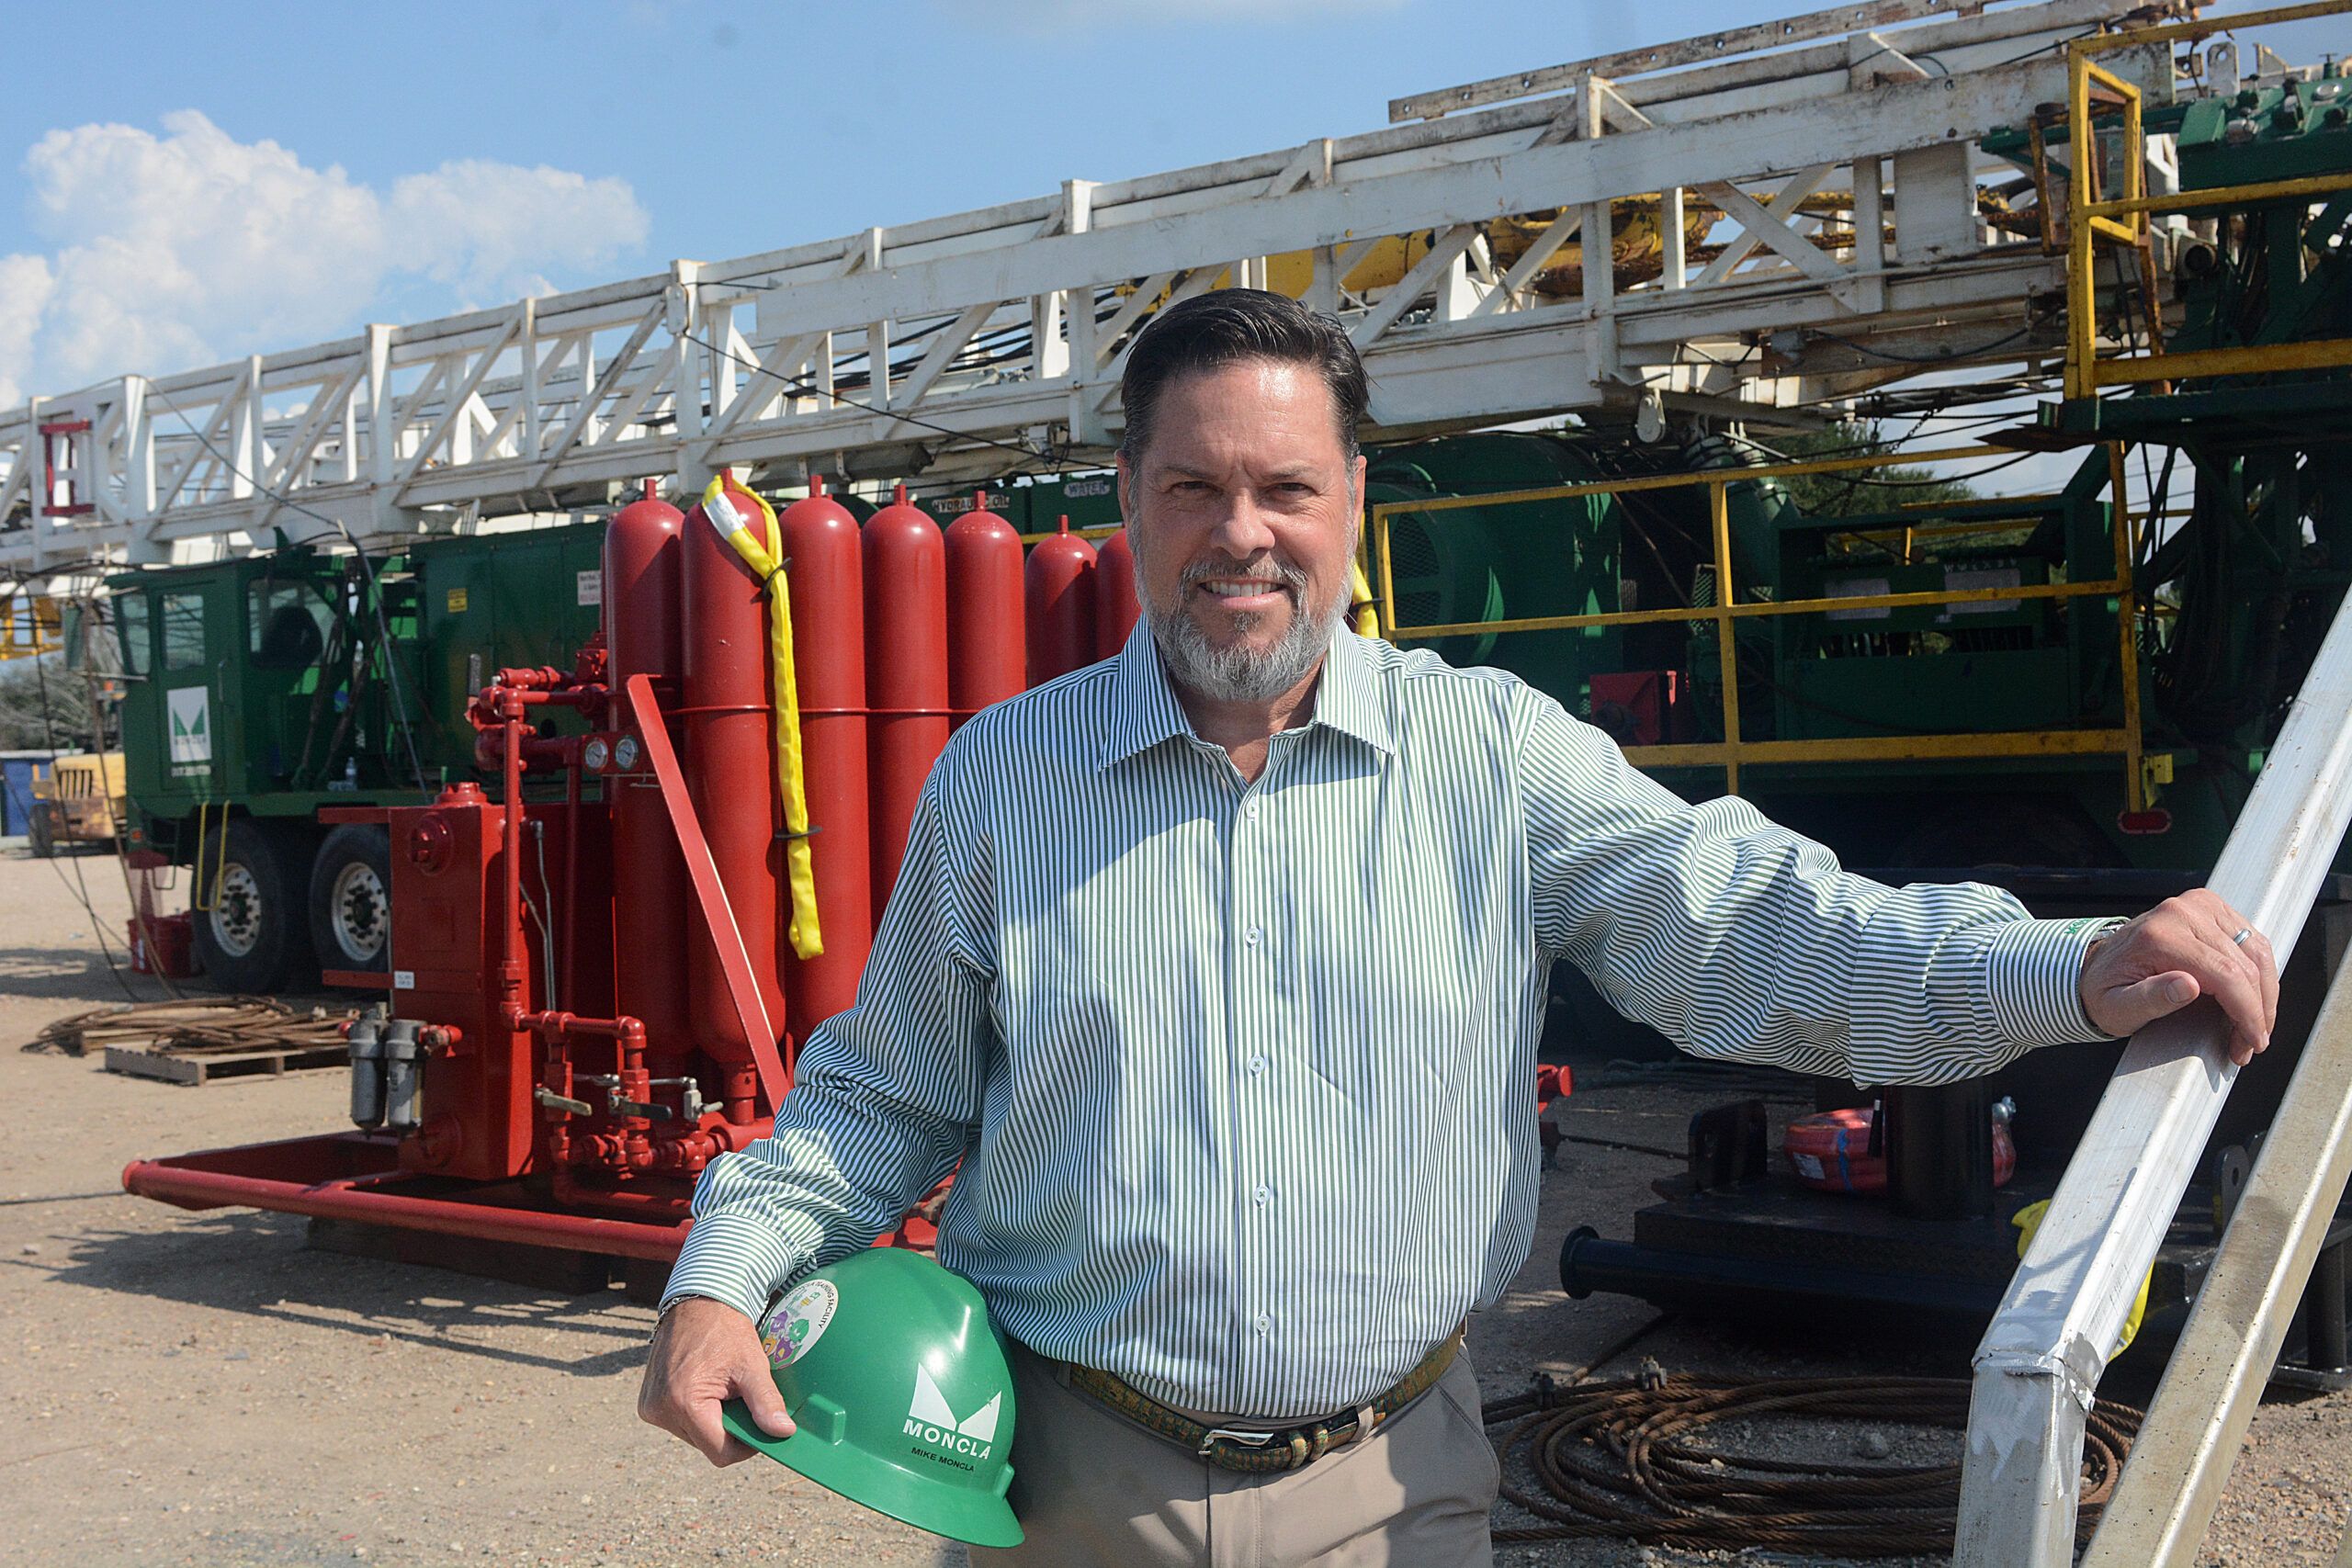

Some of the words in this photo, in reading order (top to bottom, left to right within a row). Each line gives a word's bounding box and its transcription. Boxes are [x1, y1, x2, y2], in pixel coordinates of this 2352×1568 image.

[993, 495, 1010, 507] OIL
[818, 1298, 834, 1328] FACILITY
[902, 1418, 991, 1460] MONCLA
[910, 1447, 937, 1461] MIKE
[938, 1456, 975, 1472] MONCLA
